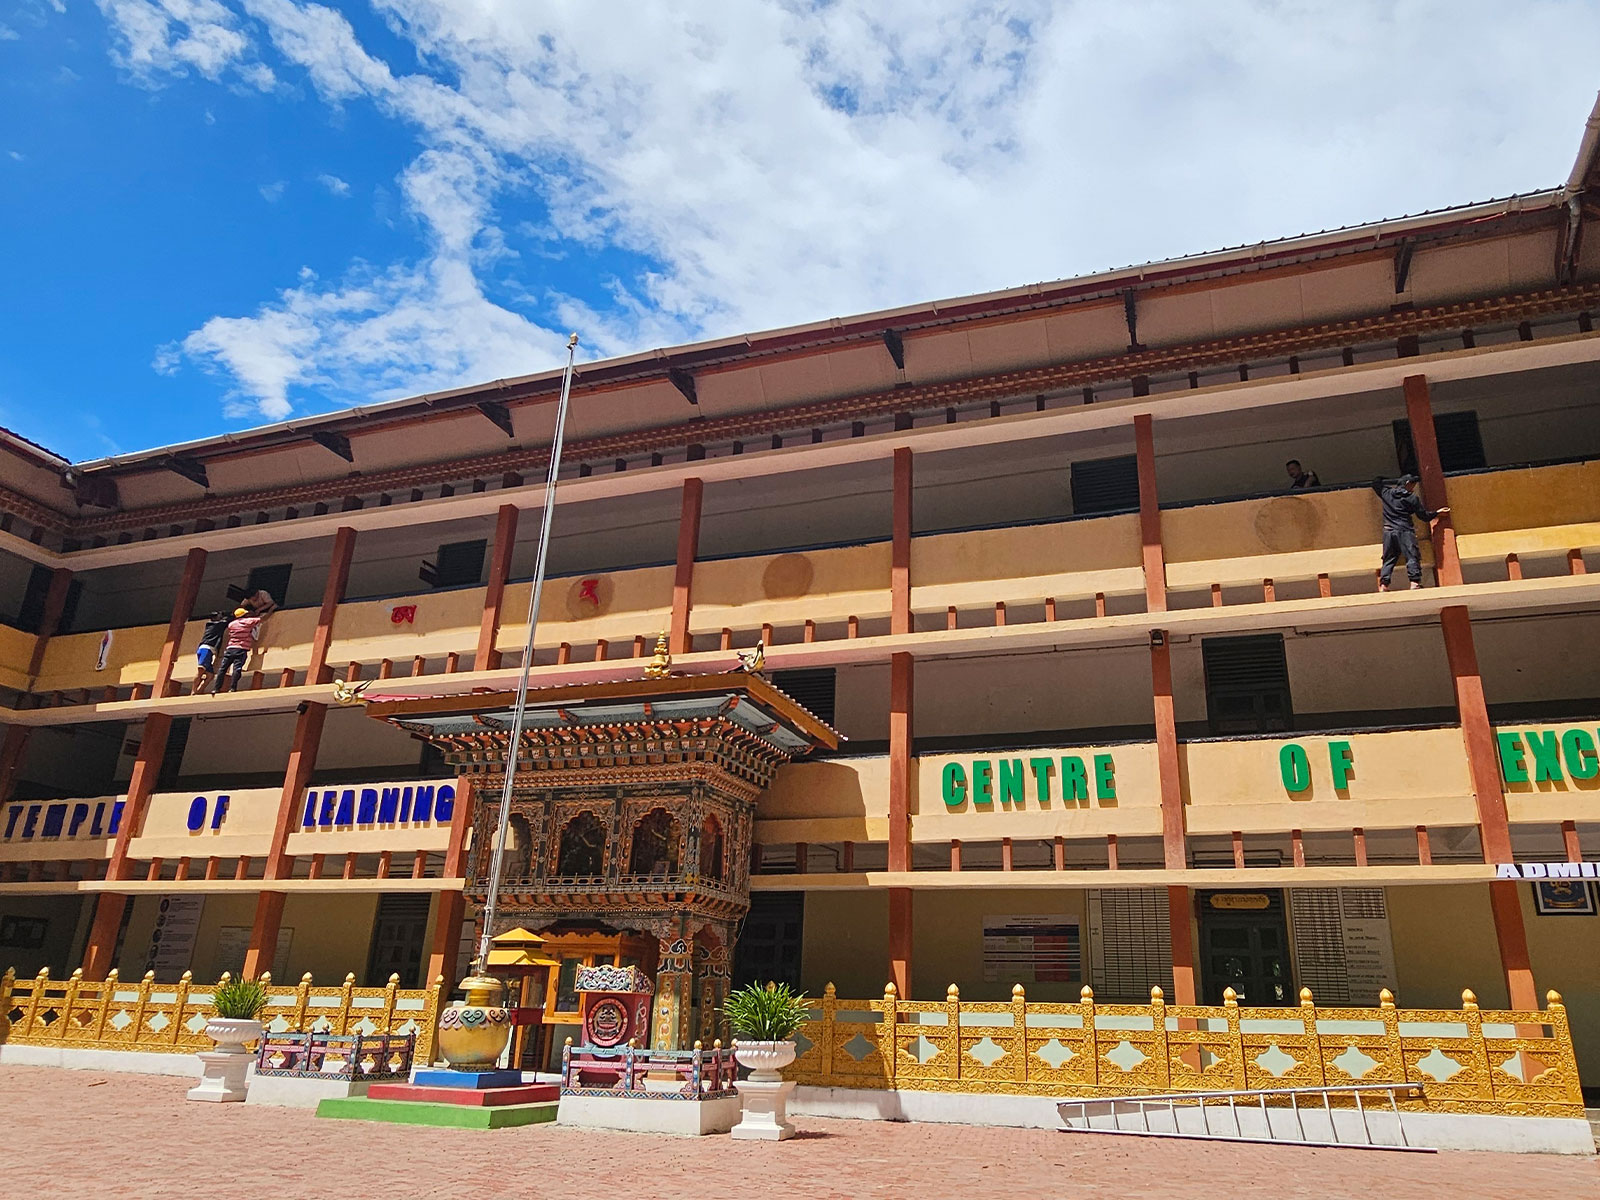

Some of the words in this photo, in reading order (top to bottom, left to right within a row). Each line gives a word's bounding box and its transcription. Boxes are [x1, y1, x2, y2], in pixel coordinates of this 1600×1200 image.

[942, 754, 1117, 806] CENTRE
[1279, 741, 1352, 792] OF
[1497, 727, 1600, 783] EXC
[187, 795, 231, 831] OF
[303, 785, 456, 827] LEARNING
[1496, 862, 1600, 879] ADMI
